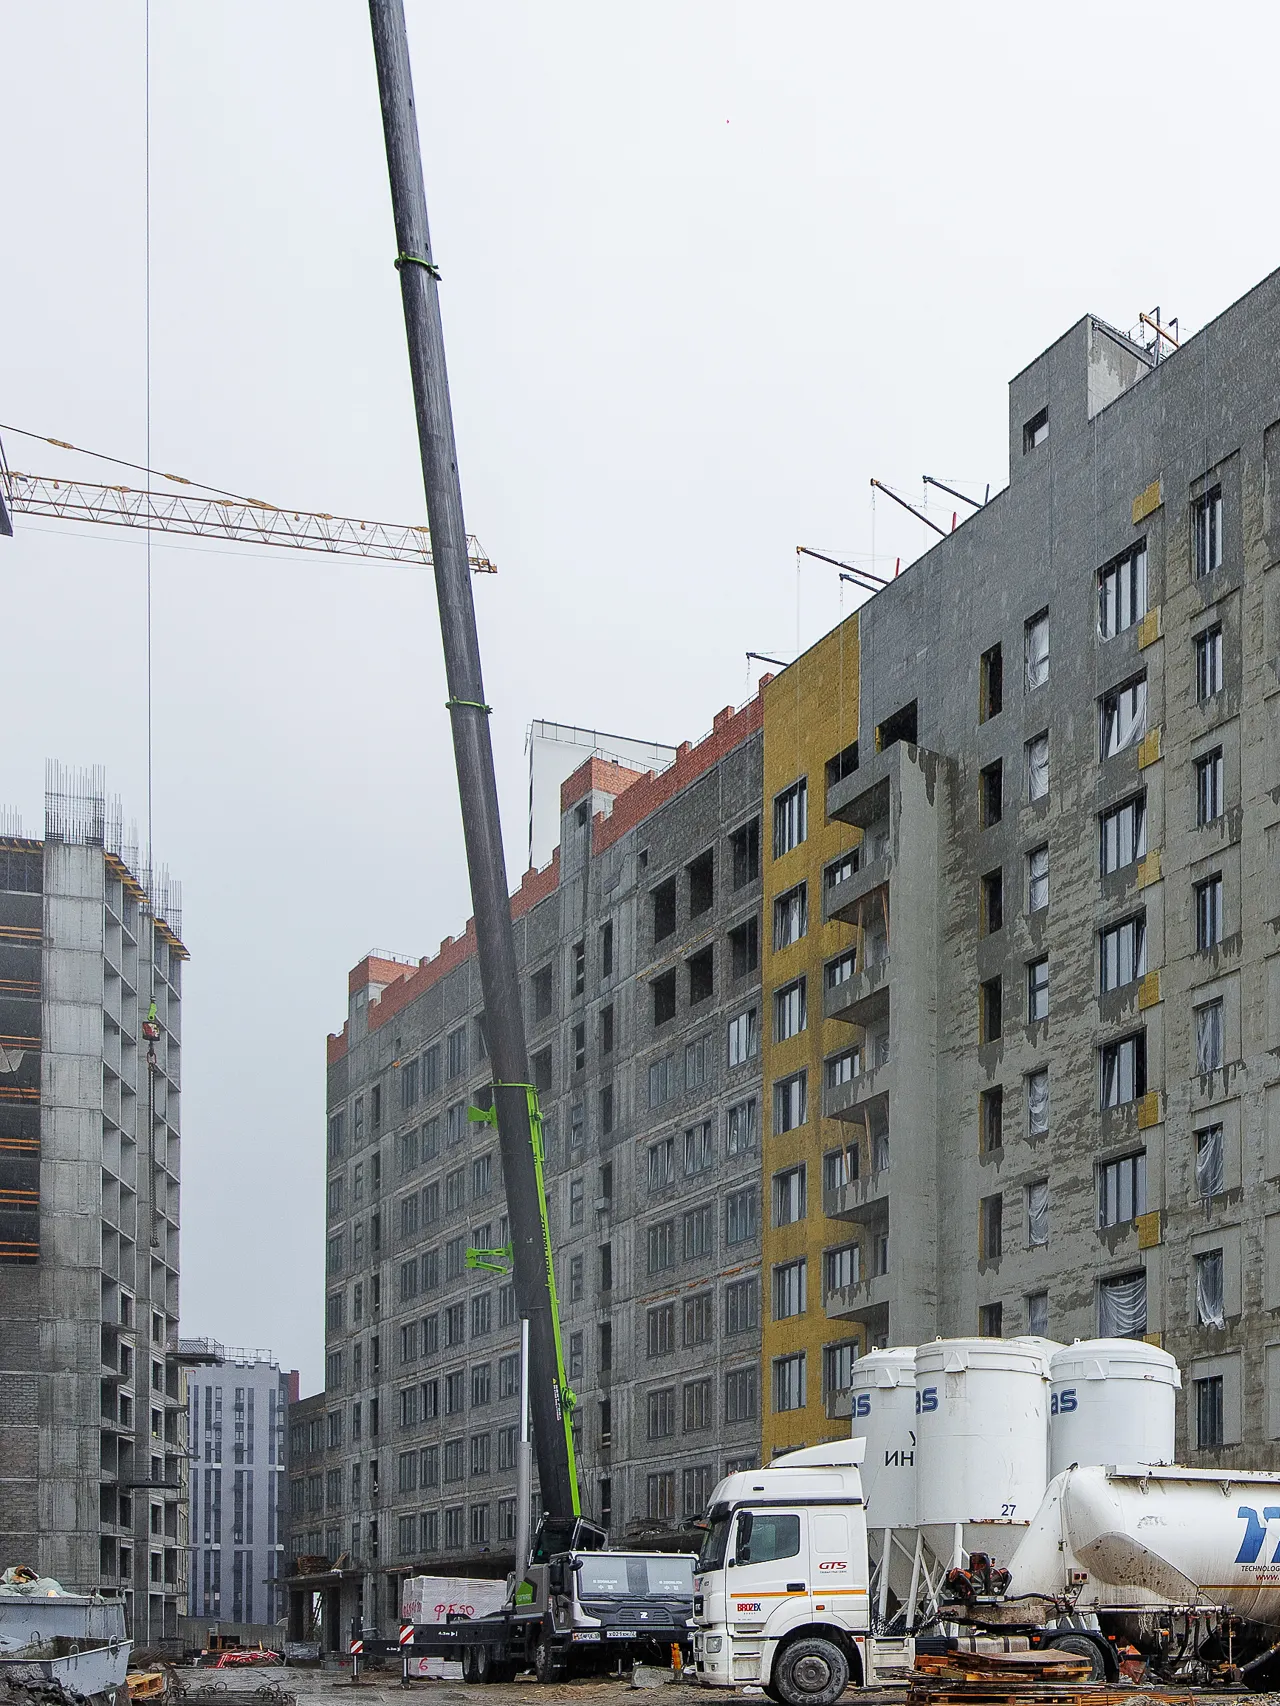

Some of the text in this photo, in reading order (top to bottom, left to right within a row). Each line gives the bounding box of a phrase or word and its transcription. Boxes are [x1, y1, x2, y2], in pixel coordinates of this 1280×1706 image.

[1001, 1504, 1016, 1517] 27
[818, 1561, 848, 1570] GTS
[737, 1602, 762, 1612] BROZEX
